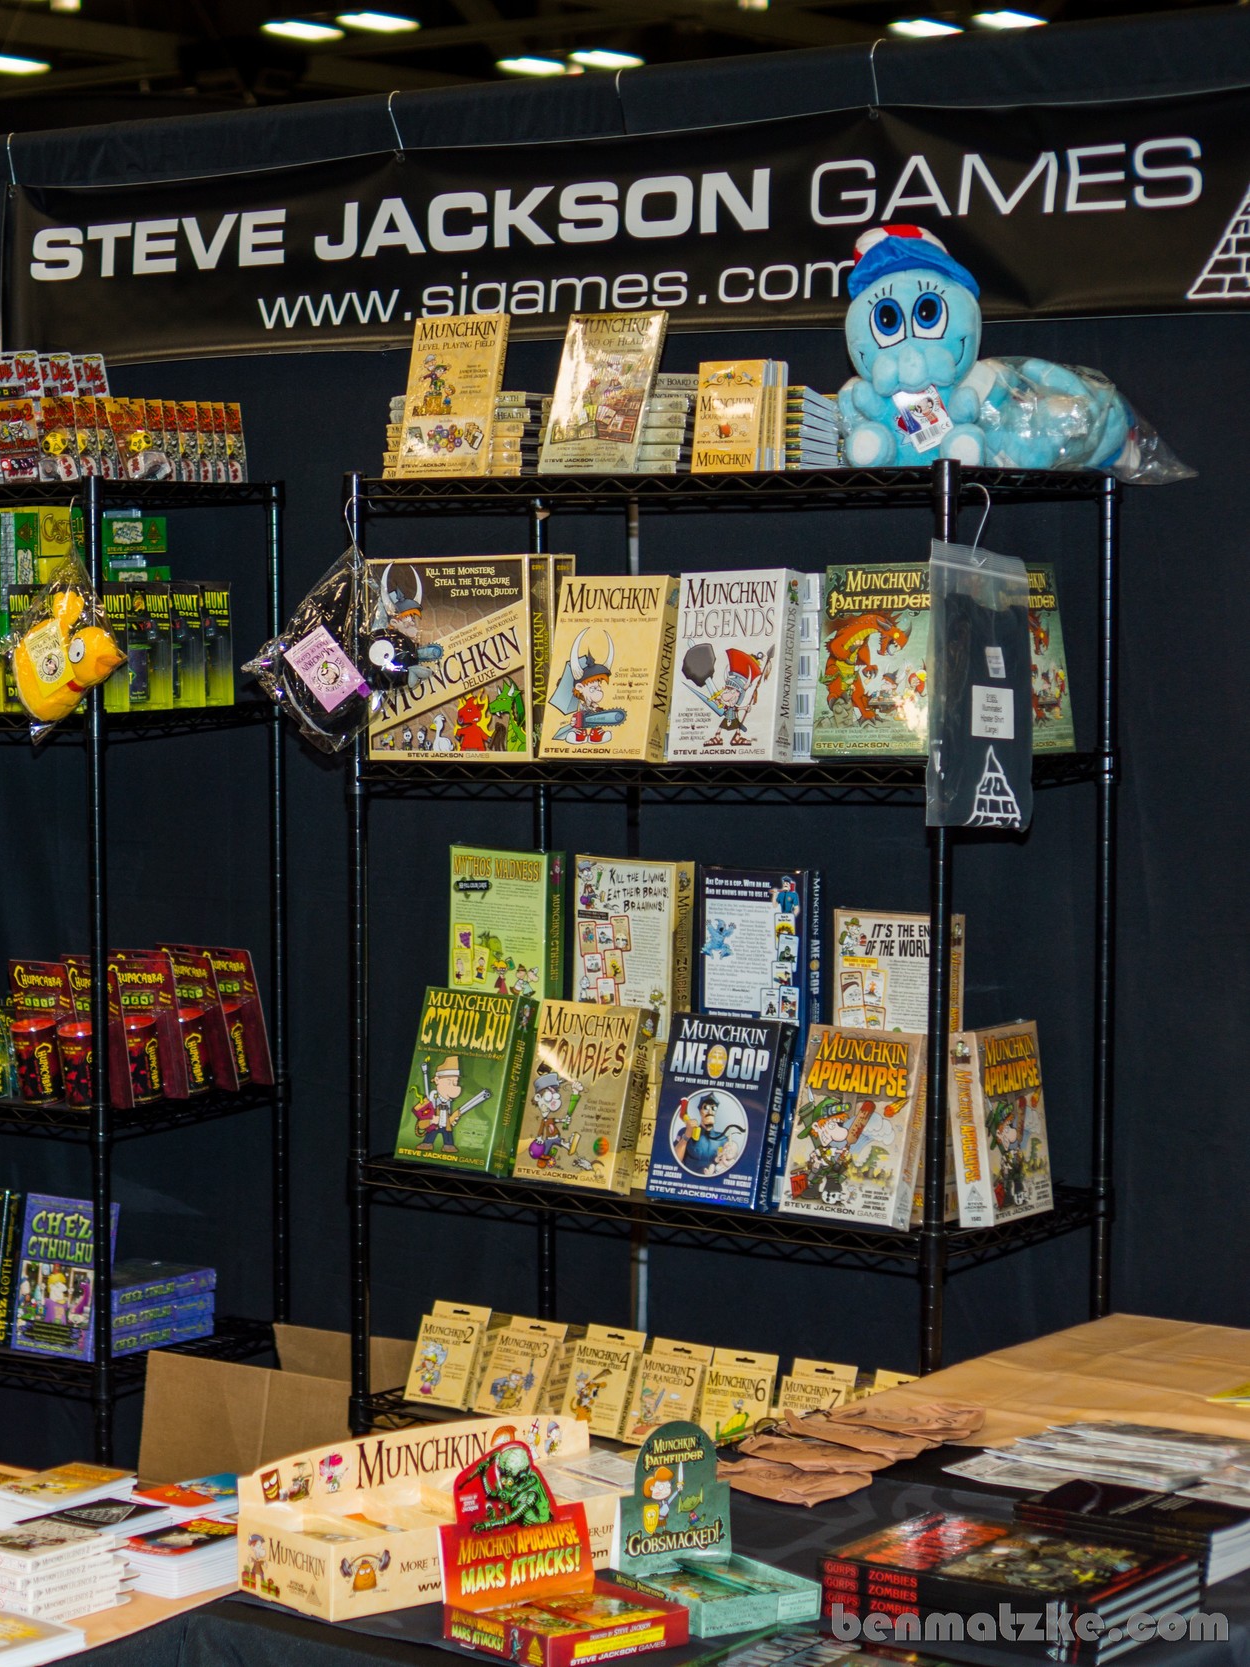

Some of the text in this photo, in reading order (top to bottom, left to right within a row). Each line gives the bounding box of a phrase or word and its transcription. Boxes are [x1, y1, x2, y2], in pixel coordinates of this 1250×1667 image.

[30, 136, 1203, 282] STEVE JACKSON GAMES
[419, 320, 499, 341] MUNCHKIN
[418, 339, 496, 352] LEVEL PLAYING FIELD
[696, 452, 752, 467] MUNCHKIN
[425, 566, 495, 578] KILL THE MONSTERS
[434, 576, 510, 587] STEAL THE TREASURE
[846, 571, 922, 592] MUNCHKIN
[9, 594, 29, 612] DINO
[205, 591, 229, 610] HUNT
[450, 587, 519, 597] STAB YOUR BUDDY
[563, 582, 661, 616] MUNCHKIN
[686, 578, 778, 611] MUNCHKIN
[829, 591, 931, 616] PATHFINDER
[681, 606, 776, 639] LEGENDS
[381, 625, 523, 722] MUNCHKIN
[462, 668, 497, 691] DELUXE
[572, 747, 611, 755] JACKSON
[453, 854, 542, 883] MYTHOS MADNESS!
[609, 867, 667, 885] KILL THE LIVING!
[607, 886, 669, 901] EAT THEIR BRAINS!
[871, 923, 931, 938] IT'S THE EN
[865, 940, 931, 957] OF THE WORL
[14, 965, 62, 990] CHUPACABRA
[427, 990, 514, 1017] MUNCHKIN
[420, 1006, 511, 1053] CTHULHU
[541, 1005, 633, 1040] MUNCHKIN
[680, 1018, 768, 1047] MUNCHKIN
[537, 1037, 627, 1081] ZOMBIES
[669, 1040, 770, 1082] AXE COP
[816, 1030, 909, 1070] MUNCHKIN
[984, 1033, 1035, 1067] MUNCHKIN
[34, 1042, 53, 1095] CHUPACABRA
[807, 1060, 908, 1098] APOCALYPSE
[984, 1057, 1040, 1098] APOCALYPSE
[649, 1185, 749, 1204] STEVE JACKSON GAMES
[784, 1200, 888, 1220] STEVE JACKSON GAMES
[32, 1210, 93, 1240] CHEZ
[27, 1235, 94, 1264] CTHULHU
[422, 1323, 474, 1344] MUNCHKIN 2
[577, 1345, 631, 1371] MUNCHKIN 4
[643, 1358, 696, 1387] MUNCHKIN 5
[707, 1370, 766, 1402] MUNCHKIN 6
[653, 1435, 697, 1455] MUNCHKIN
[356, 1431, 487, 1490] MUNCHKIN
[644, 1448, 704, 1471] PATHFINDER
[457, 1521, 580, 1567] MUNCHKIN APOCALYPSE
[628, 1523, 722, 1557] GOBSMACKED!
[268, 1537, 326, 1581] MUNCHKIN
[400, 1557, 428, 1573] MORE
[460, 1544, 582, 1596] MARS ATTACKS!
[825, 1562, 917, 1589] GURPS ZOMBIES
[570, 1653, 596, 1666] STEVE
[598, 1646, 637, 1660] JACKSON
[638, 1639, 667, 1652] GAMES
